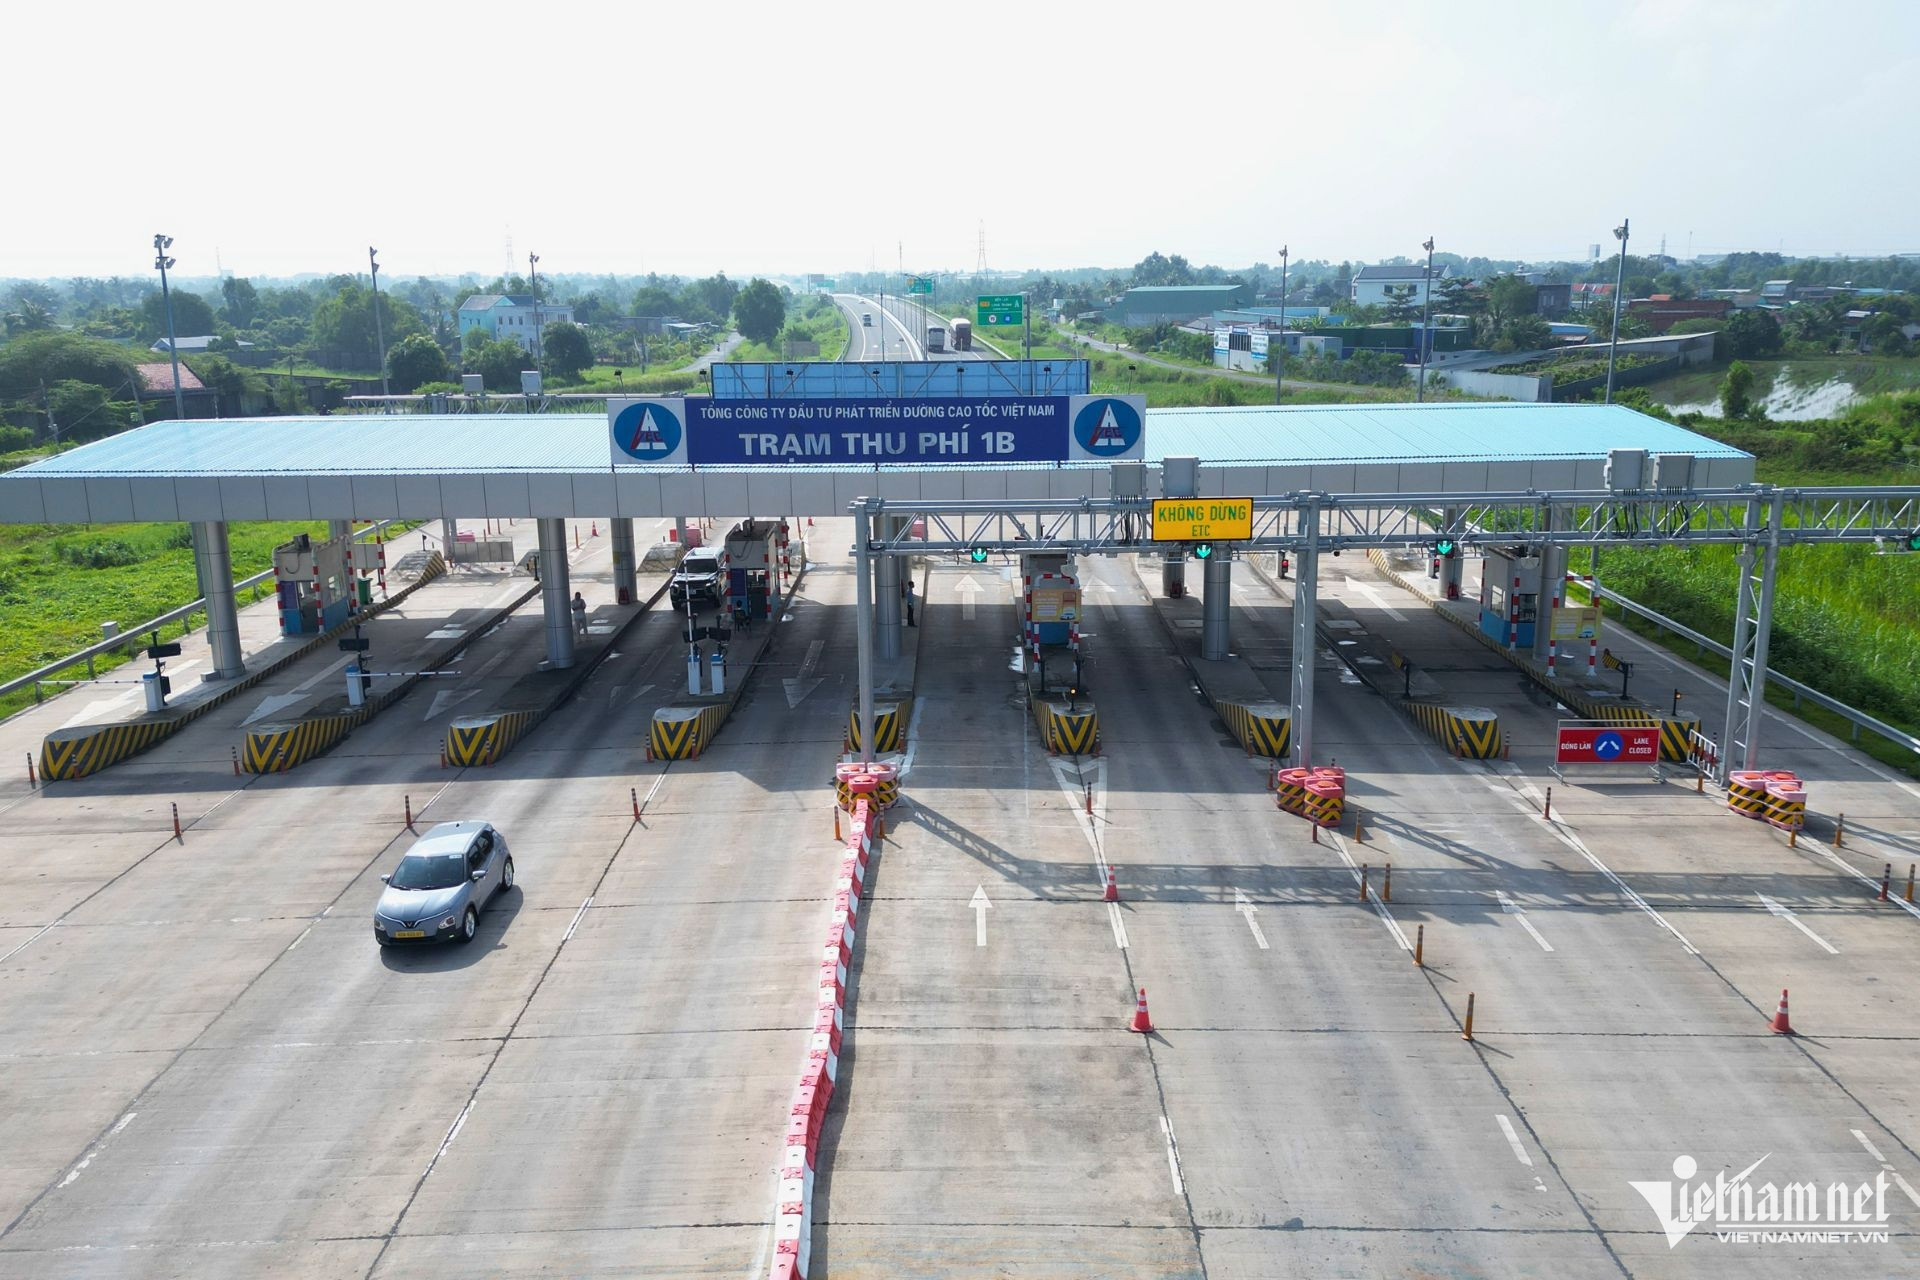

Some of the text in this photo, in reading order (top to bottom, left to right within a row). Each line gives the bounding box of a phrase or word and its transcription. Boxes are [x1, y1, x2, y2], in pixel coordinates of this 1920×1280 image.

[701, 401, 732, 419] TỔNG
[735, 404, 768, 419] CÔNG
[771, 407, 785, 419] TY
[817, 406, 833, 419] TƯ
[835, 404, 865, 419] PHÁT
[868, 401, 900, 418] TRIỂN
[903, 403, 945, 418] ĐƯỜNG
[947, 405, 972, 418] CAO
[975, 400, 998, 417] TỐC
[1001, 402, 1026, 420] VIỆT
[1028, 405, 1055, 417] NAM
[738, 423, 1015, 463] TRẠM THU PHÍ 1B
[1158, 502, 1246, 522] KHÔNG DỪNG
[1192, 525, 1210, 537] ETC
